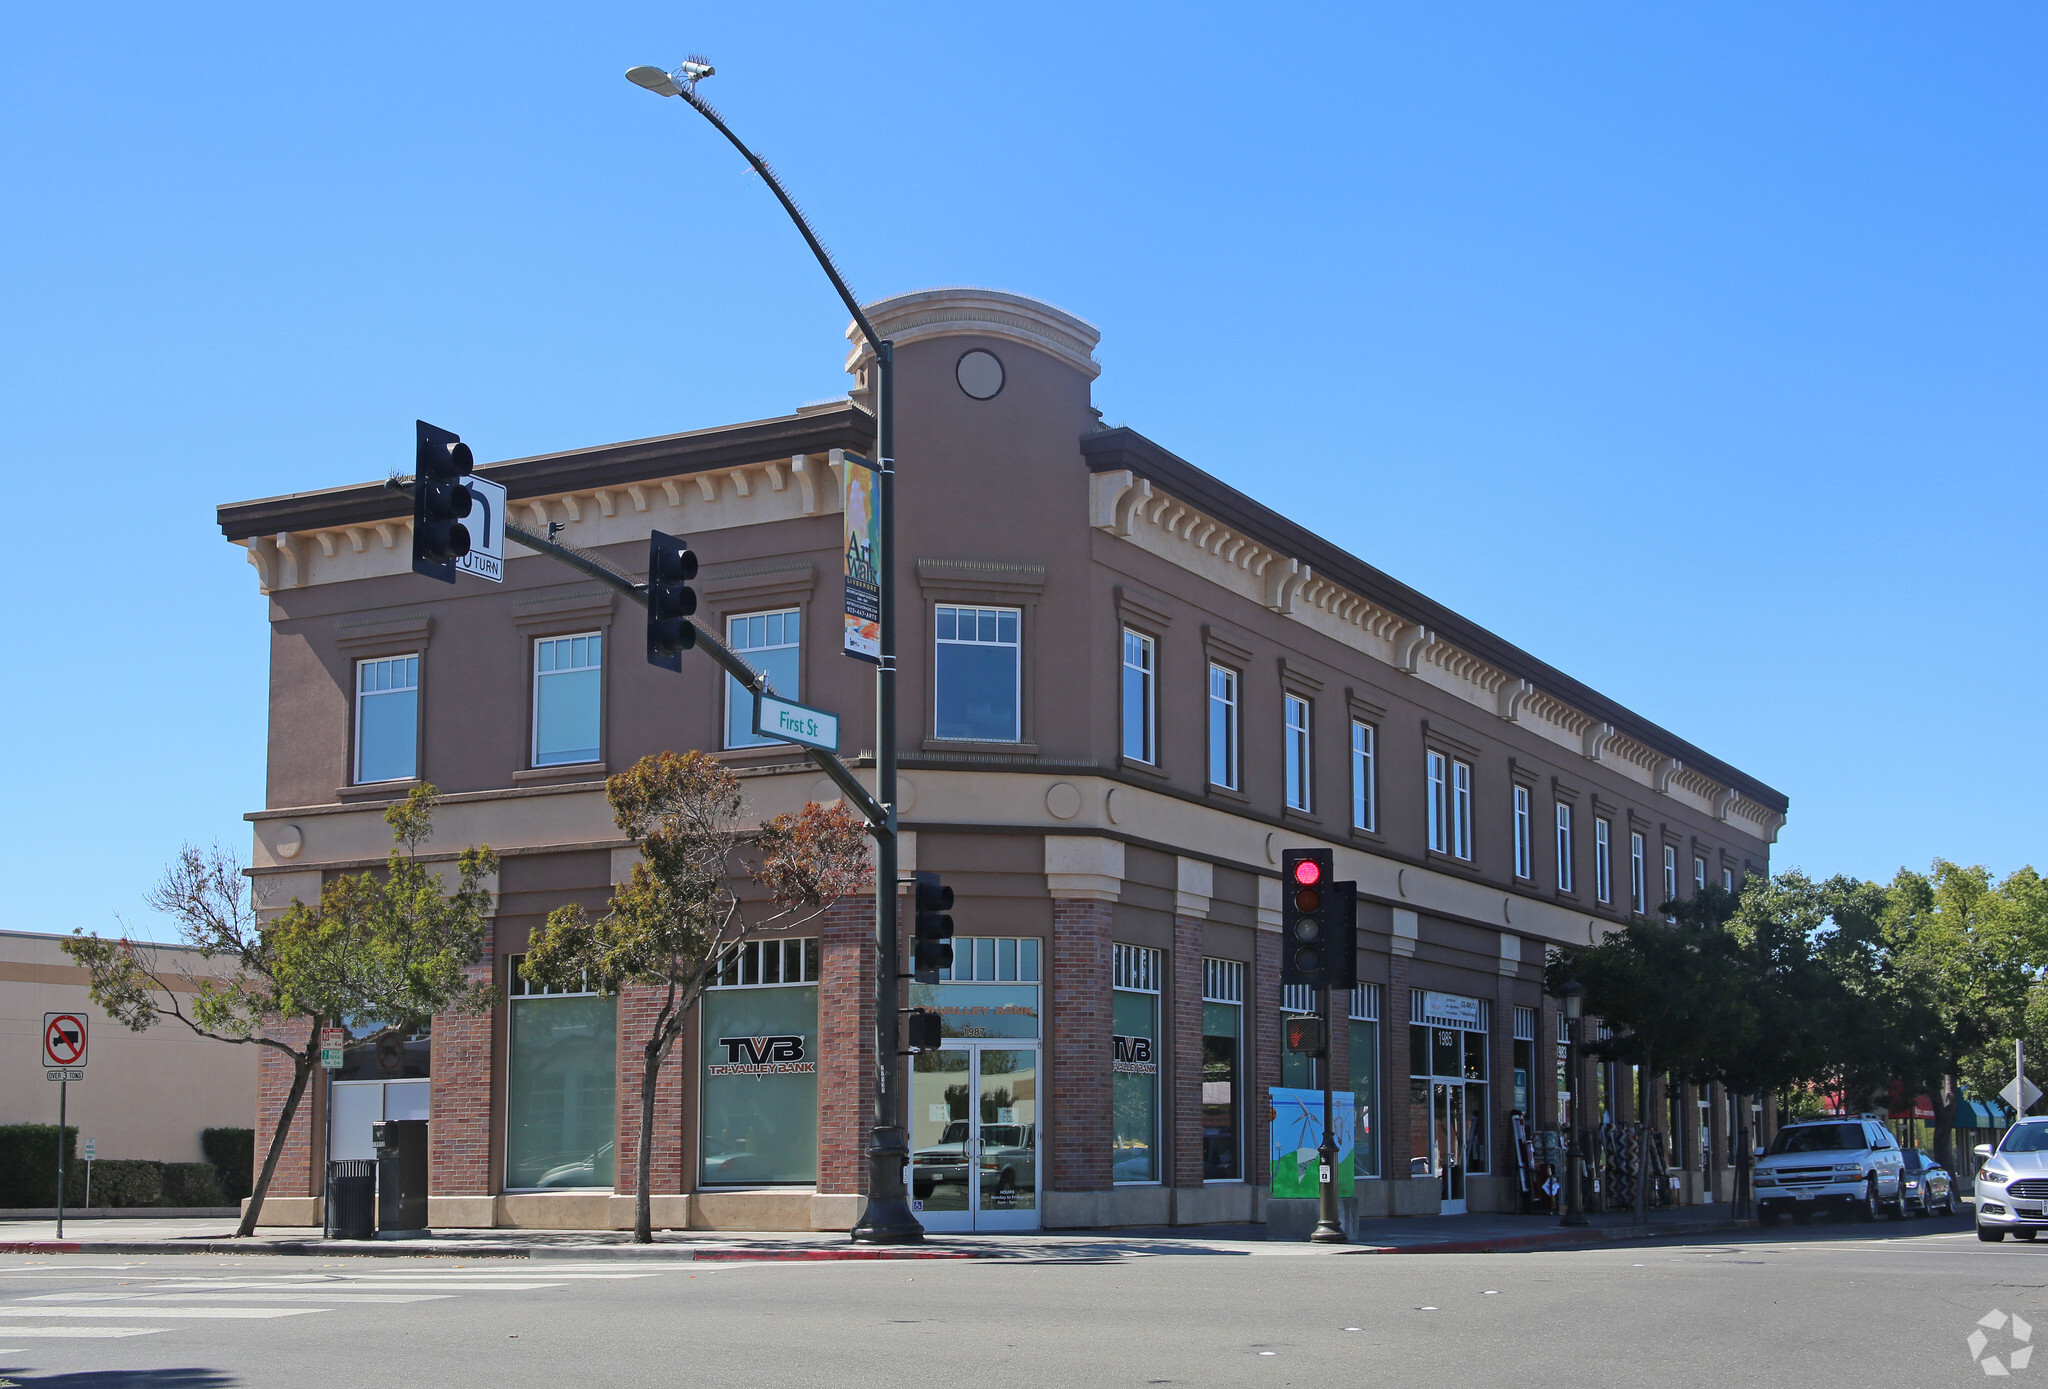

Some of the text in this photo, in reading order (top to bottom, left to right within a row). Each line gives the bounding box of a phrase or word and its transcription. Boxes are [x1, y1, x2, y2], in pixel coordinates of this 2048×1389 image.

[846, 530, 874, 569] Art
[474, 556, 498, 575] TURN
[846, 557, 878, 586] Walk
[847, 577, 877, 593] LIVERMORE
[780, 711, 818, 737] First St
[994, 1006, 1034, 1015] BANK
[963, 1027, 986, 1037] 1987
[1438, 1030, 1453, 1046] 1985
[719, 1035, 805, 1067] TVB
[1113, 1035, 1151, 1063] TVB
[63, 1071, 68, 1080] 3
[709, 1062, 815, 1075] TRI-VALLEY BANK
